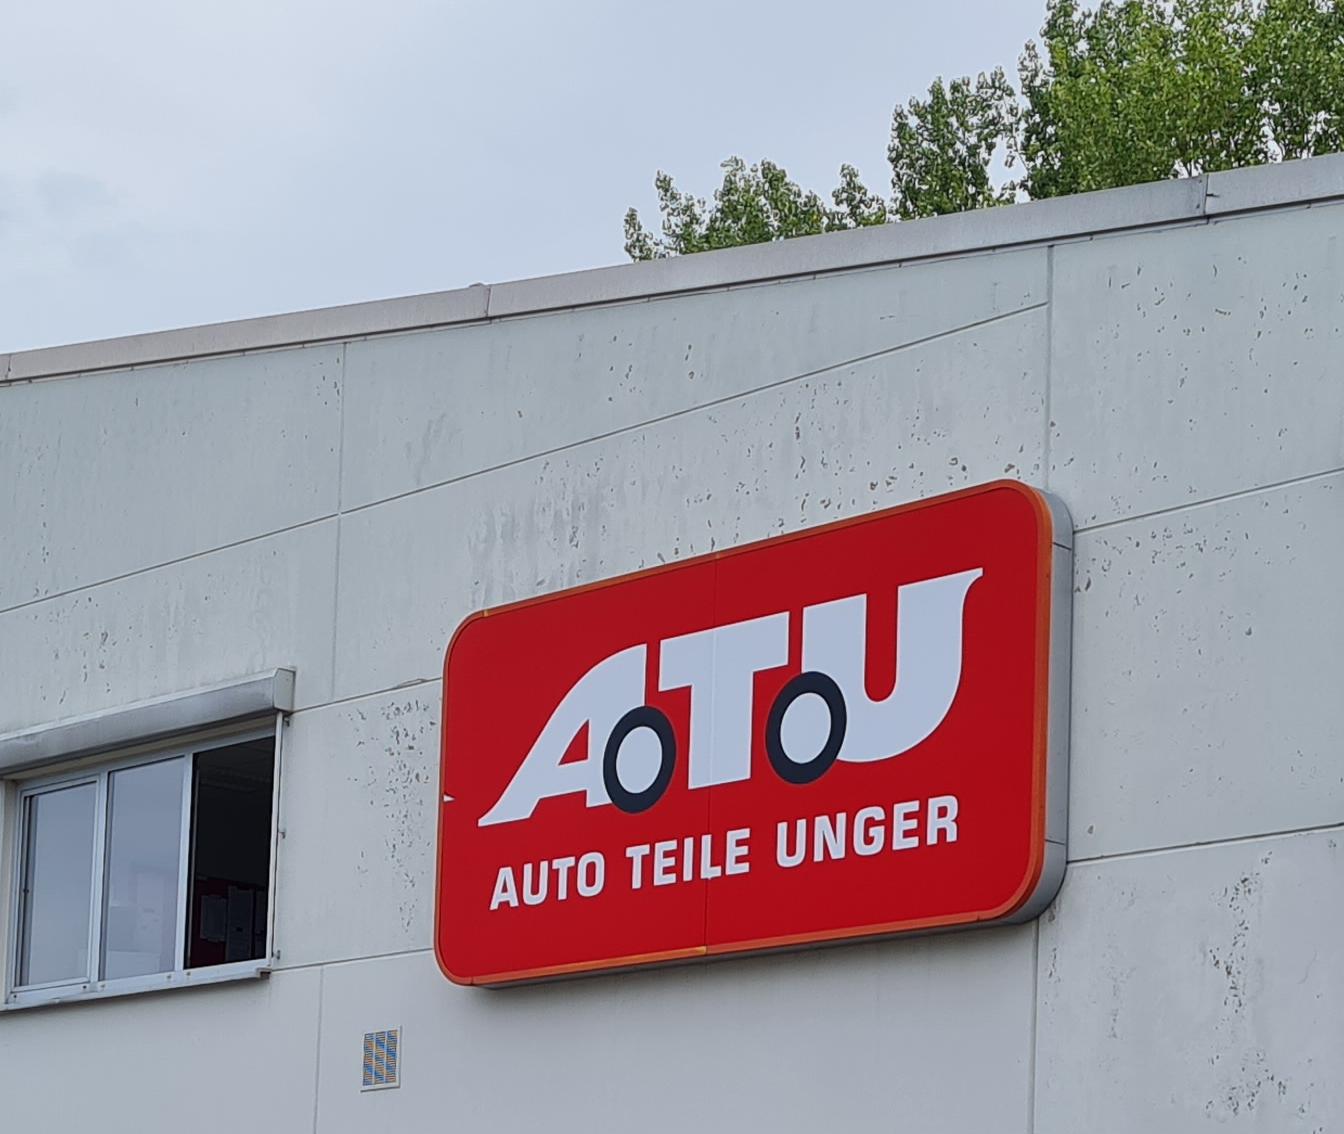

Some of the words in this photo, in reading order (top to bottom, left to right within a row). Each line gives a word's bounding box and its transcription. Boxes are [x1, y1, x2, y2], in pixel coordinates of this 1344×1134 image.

[478, 567, 983, 827] ATU
[489, 851, 605, 911] AUTO
[625, 828, 751, 889] TEILE
[775, 795, 958, 868] UNGER
